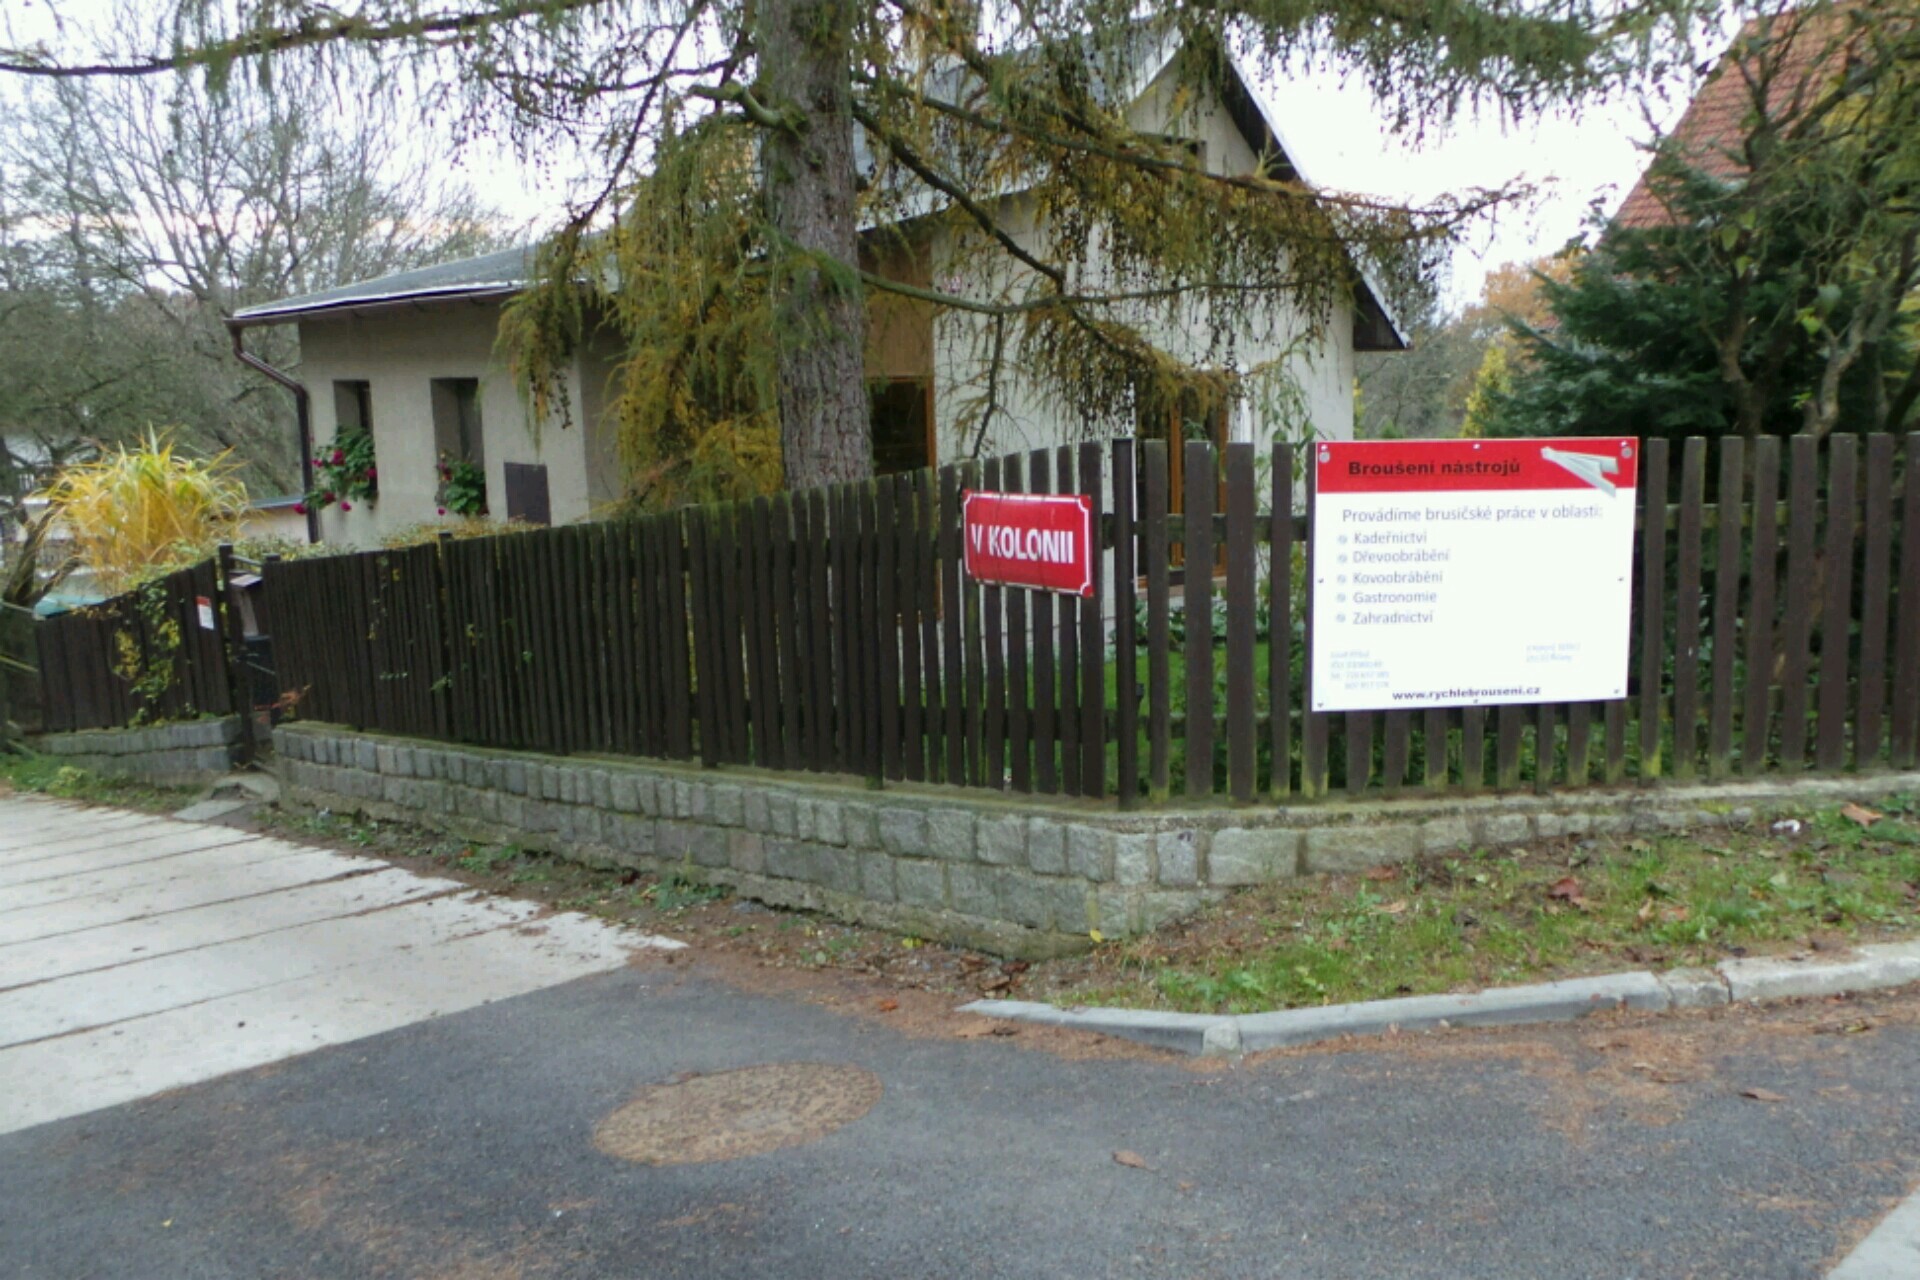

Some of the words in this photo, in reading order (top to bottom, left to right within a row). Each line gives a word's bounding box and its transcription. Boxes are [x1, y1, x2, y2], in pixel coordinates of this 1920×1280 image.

[1348, 460, 1435, 475] Broušení
[1441, 458, 1520, 476] nástrojů
[1342, 507, 1421, 522] Provádíme
[1425, 505, 1492, 520] brusičské
[1497, 505, 1536, 522] práce
[1540, 509, 1548, 519] v
[971, 523, 983, 554] V
[988, 525, 1074, 564] KOLONII
[1353, 530, 1428, 545] Kadeřnictví
[1352, 548, 1450, 564] Dřevoobrábění
[1352, 570, 1443, 585] Kovoobrábění
[1352, 591, 1437, 604] Gastronomie
[1352, 610, 1433, 625] Zahradnictví
[1392, 686, 1541, 700] www.rychlebrouseni.cz
